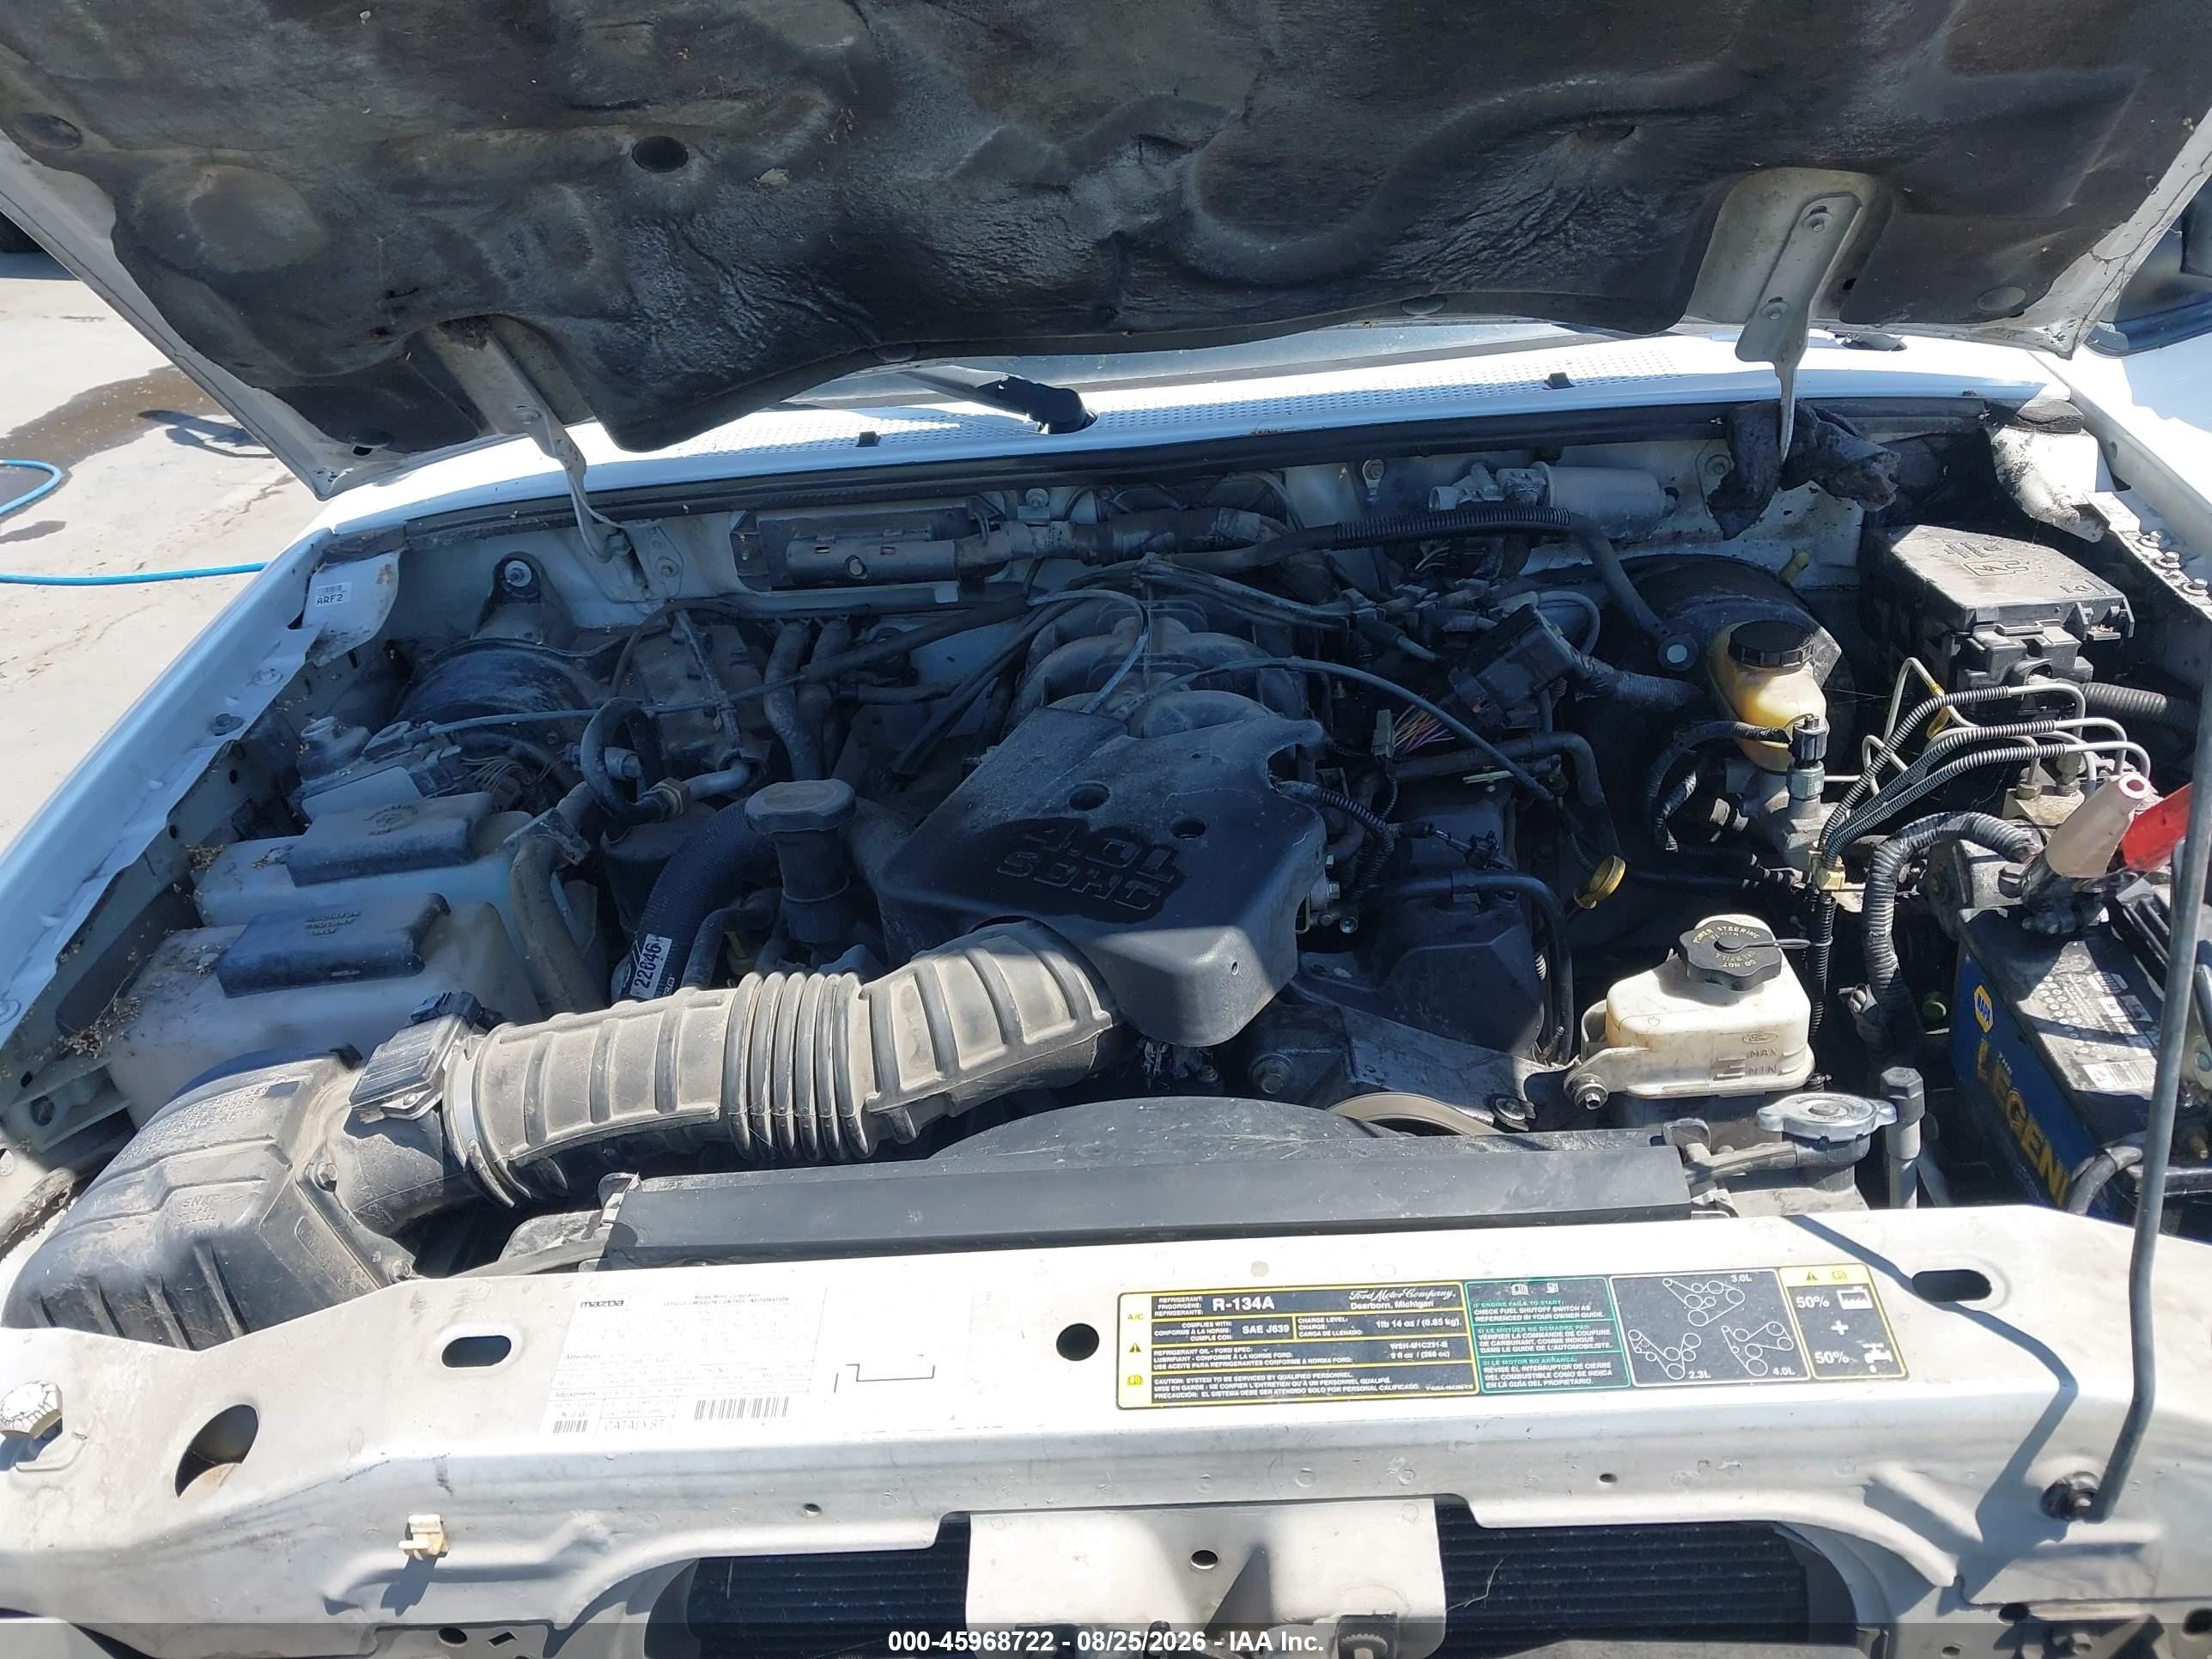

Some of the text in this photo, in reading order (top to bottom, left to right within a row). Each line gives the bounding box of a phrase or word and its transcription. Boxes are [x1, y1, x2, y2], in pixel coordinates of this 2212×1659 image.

[316, 593, 343, 605] ARF2
[1692, 926, 1760, 944] POWER STEERING
[1976, 994, 1990, 1024] NAPA
[1750, 1048, 1778, 1058] MAX
[1978, 1039, 2070, 1206] LEGEN
[1730, 1274, 1752, 1283] 3.0L
[1349, 1290, 1374, 1300] Ford
[1373, 1289, 1403, 1302] Motor
[580, 1300, 624, 1309] mazda
[1212, 1296, 1275, 1312] R-134A
[1350, 1300, 1434, 1310] Dearborn, Michigan
[1796, 1296, 1830, 1309] 50%
[1242, 1324, 1290, 1334] SAE J639
[1814, 1352, 1850, 1364] 50%
[1688, 1370, 1711, 1379] 2.3L
[1772, 1367, 1796, 1376] 4.0L
